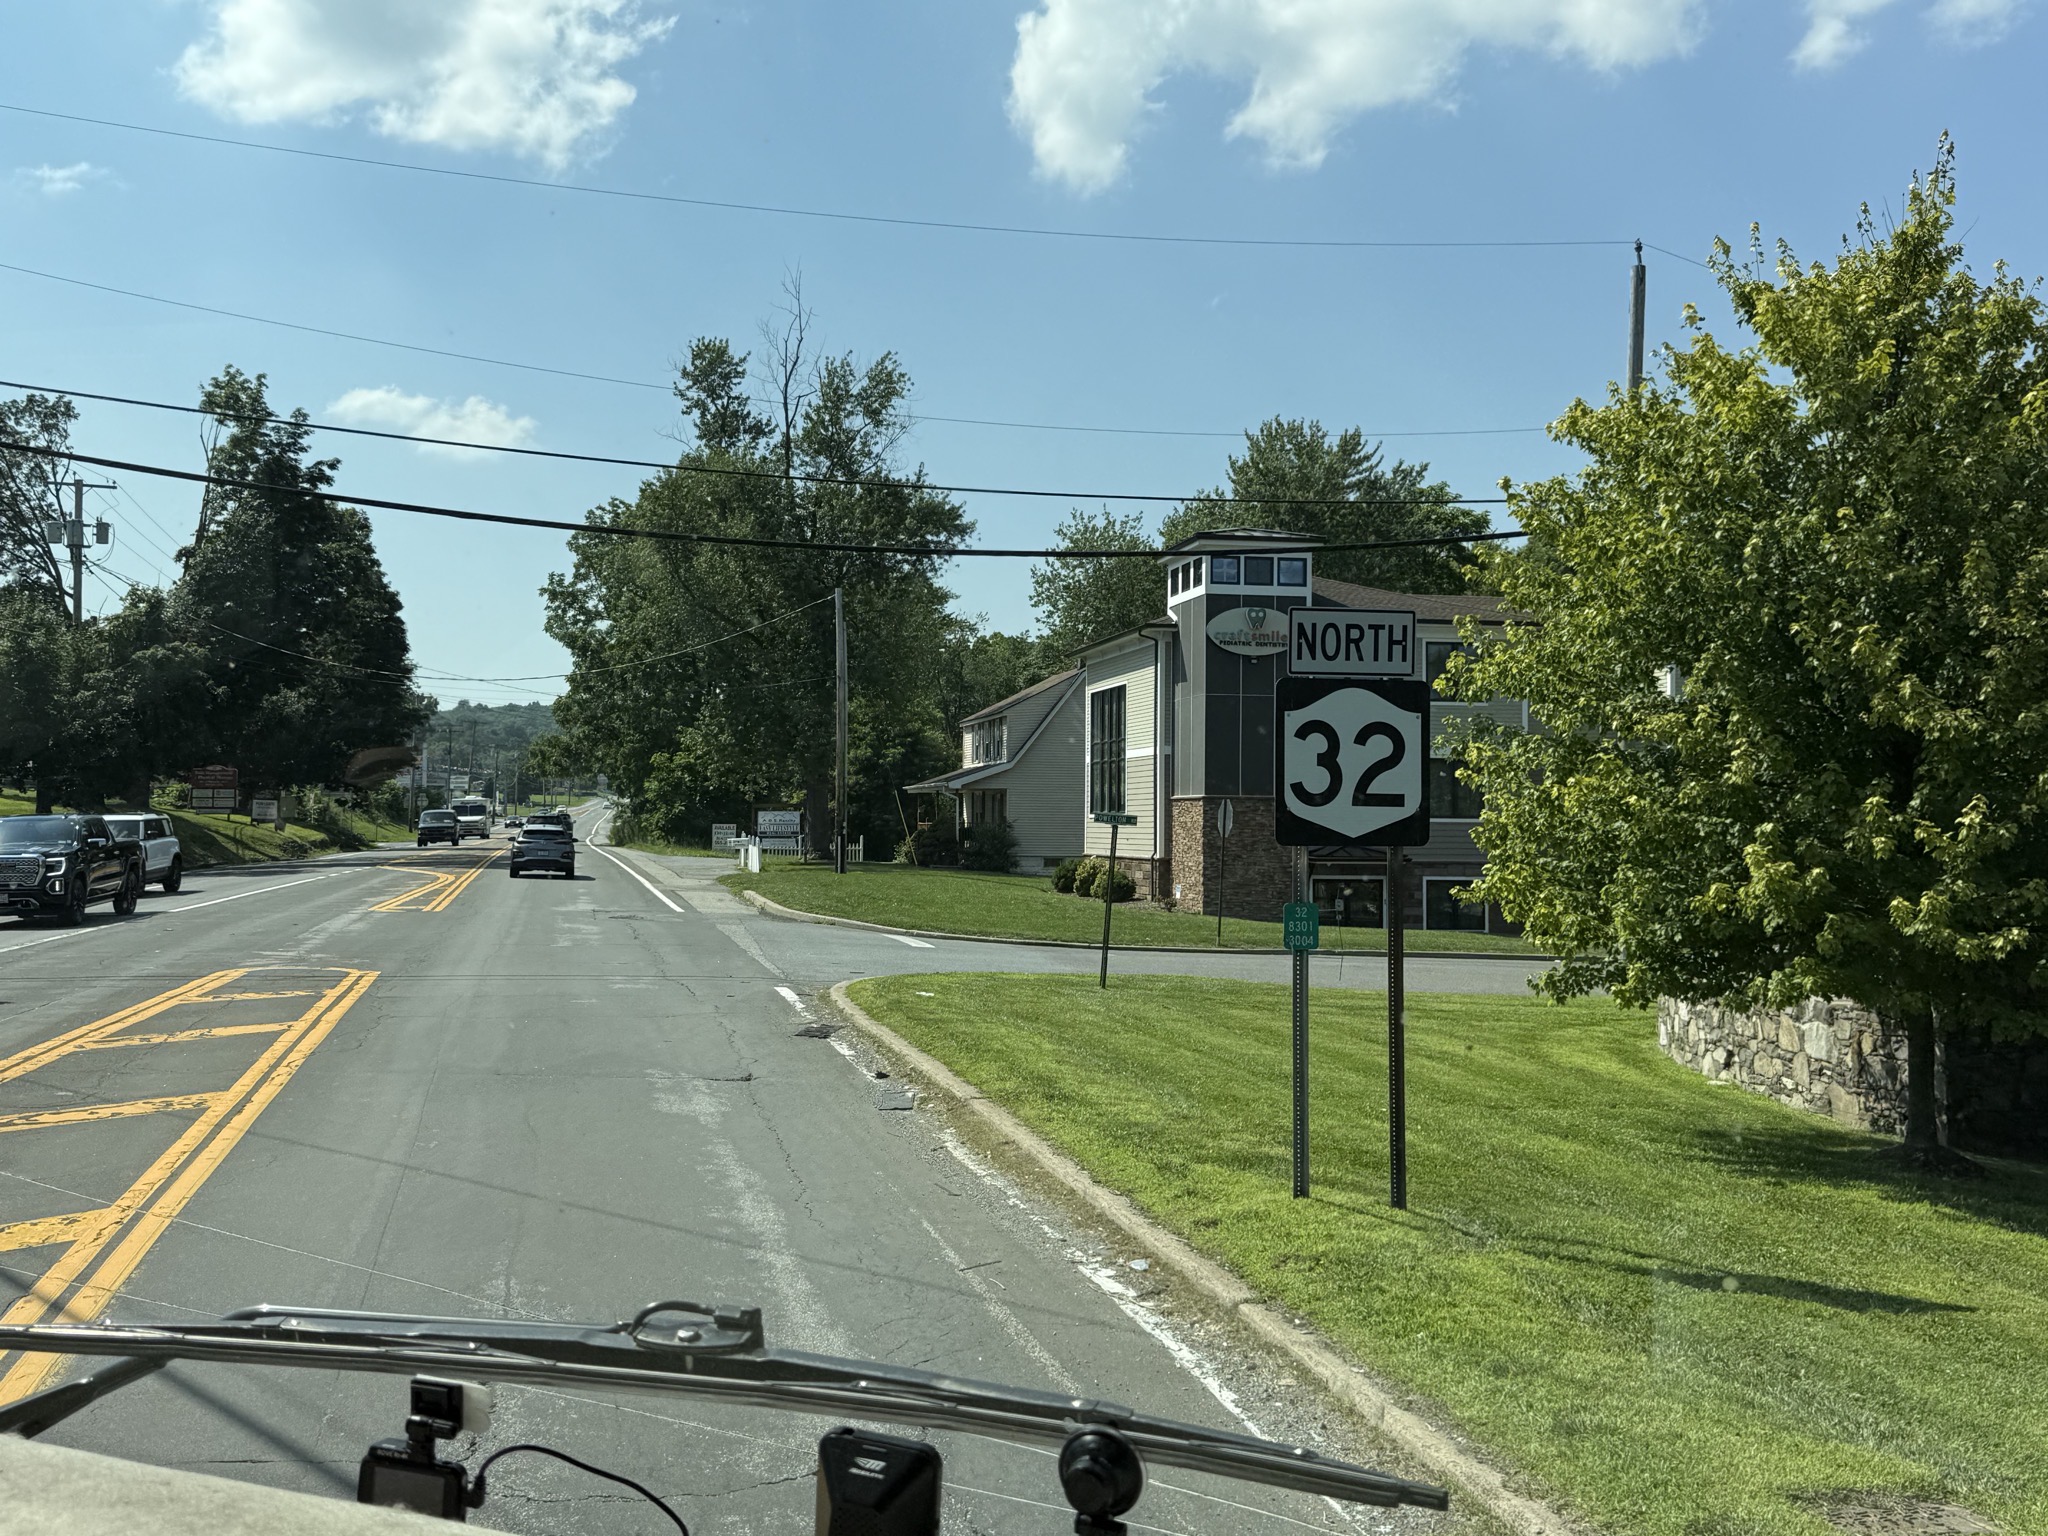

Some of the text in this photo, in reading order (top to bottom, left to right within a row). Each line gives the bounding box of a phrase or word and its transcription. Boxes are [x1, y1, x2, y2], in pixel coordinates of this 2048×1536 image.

[1297, 622, 1408, 662] NORTH
[1289, 719, 1406, 807] 32
[1094, 814, 1127, 823] POWELTON
[1295, 907, 1308, 918] 32
[1288, 921, 1313, 932] 8301
[1288, 935, 1314, 946] 3004
